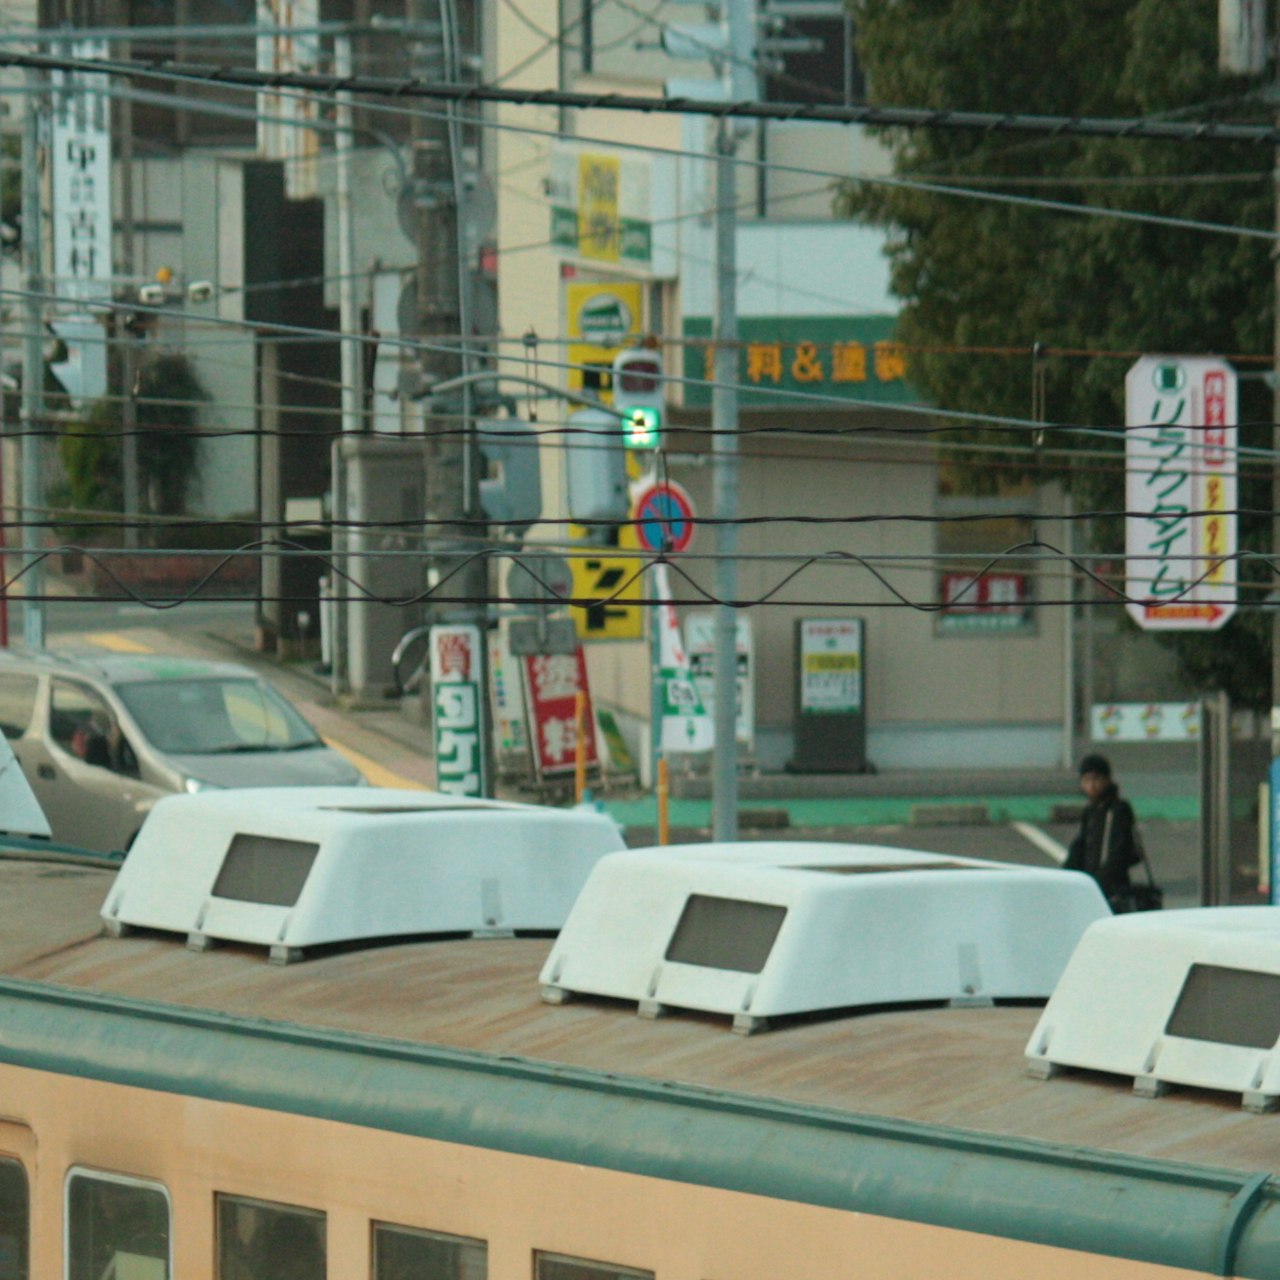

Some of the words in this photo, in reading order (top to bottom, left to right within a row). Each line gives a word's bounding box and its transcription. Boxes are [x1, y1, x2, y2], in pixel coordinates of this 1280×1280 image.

[1146, 399, 1188, 595] リラクタイム
